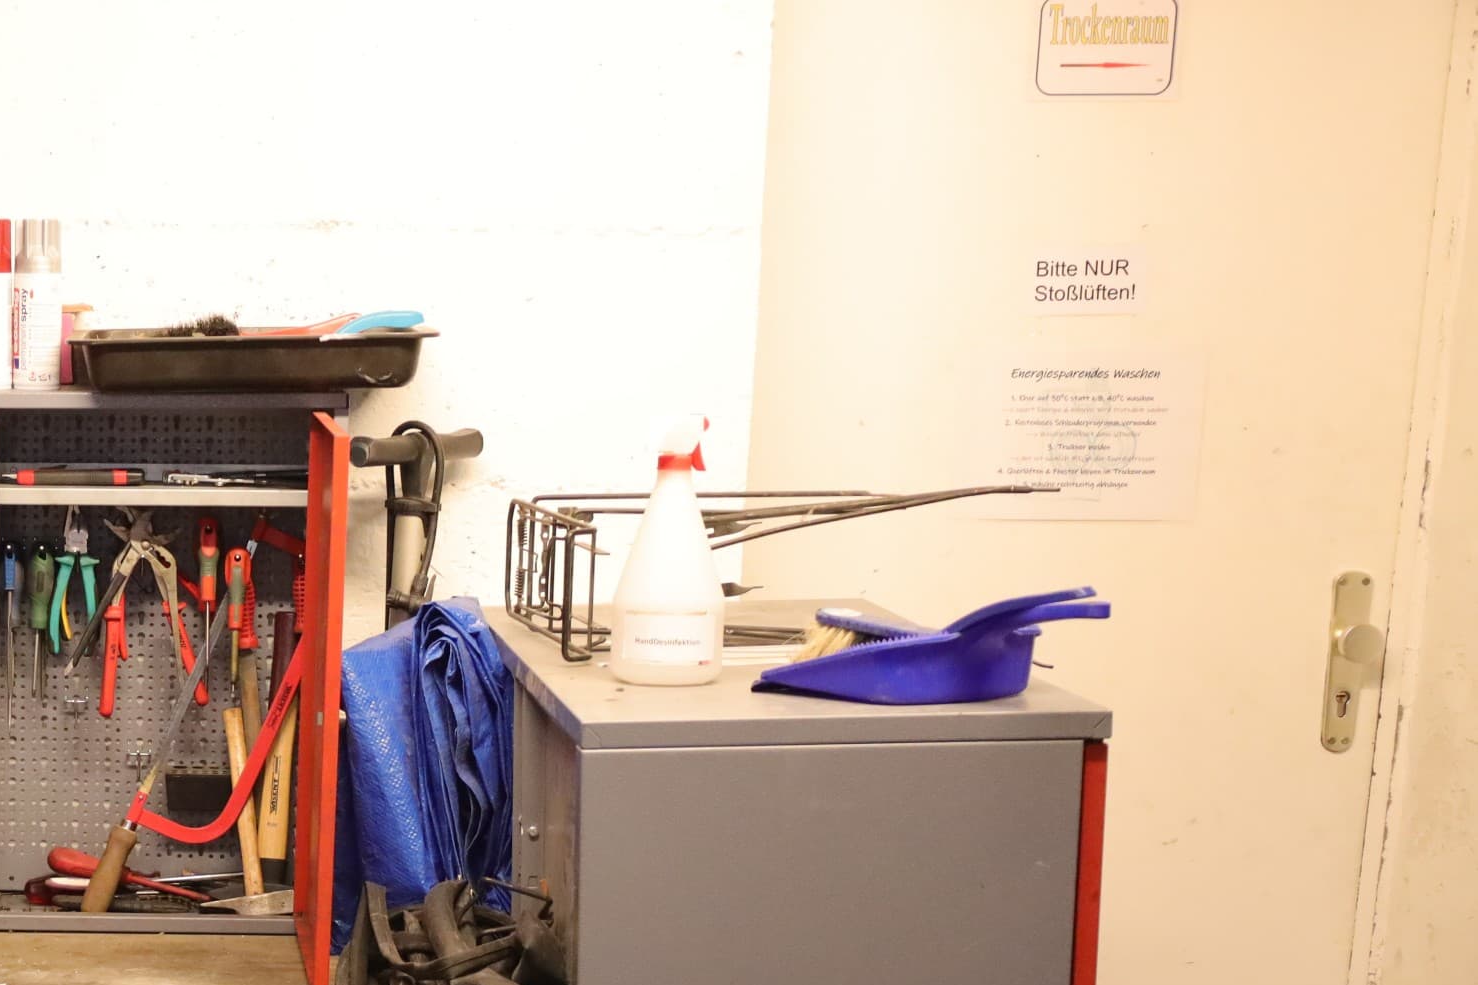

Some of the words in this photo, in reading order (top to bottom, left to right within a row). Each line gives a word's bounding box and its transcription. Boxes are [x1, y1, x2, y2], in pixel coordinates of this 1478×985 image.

[1049, 3, 1170, 45] Trockenraum
[1035, 260, 1078, 277] Bitte
[1084, 258, 1129, 276] NUR
[1034, 283, 1136, 302] Stoßlüften!
[1010, 367, 1109, 383] Energiesparendes
[1113, 367, 1161, 379] Waschen
